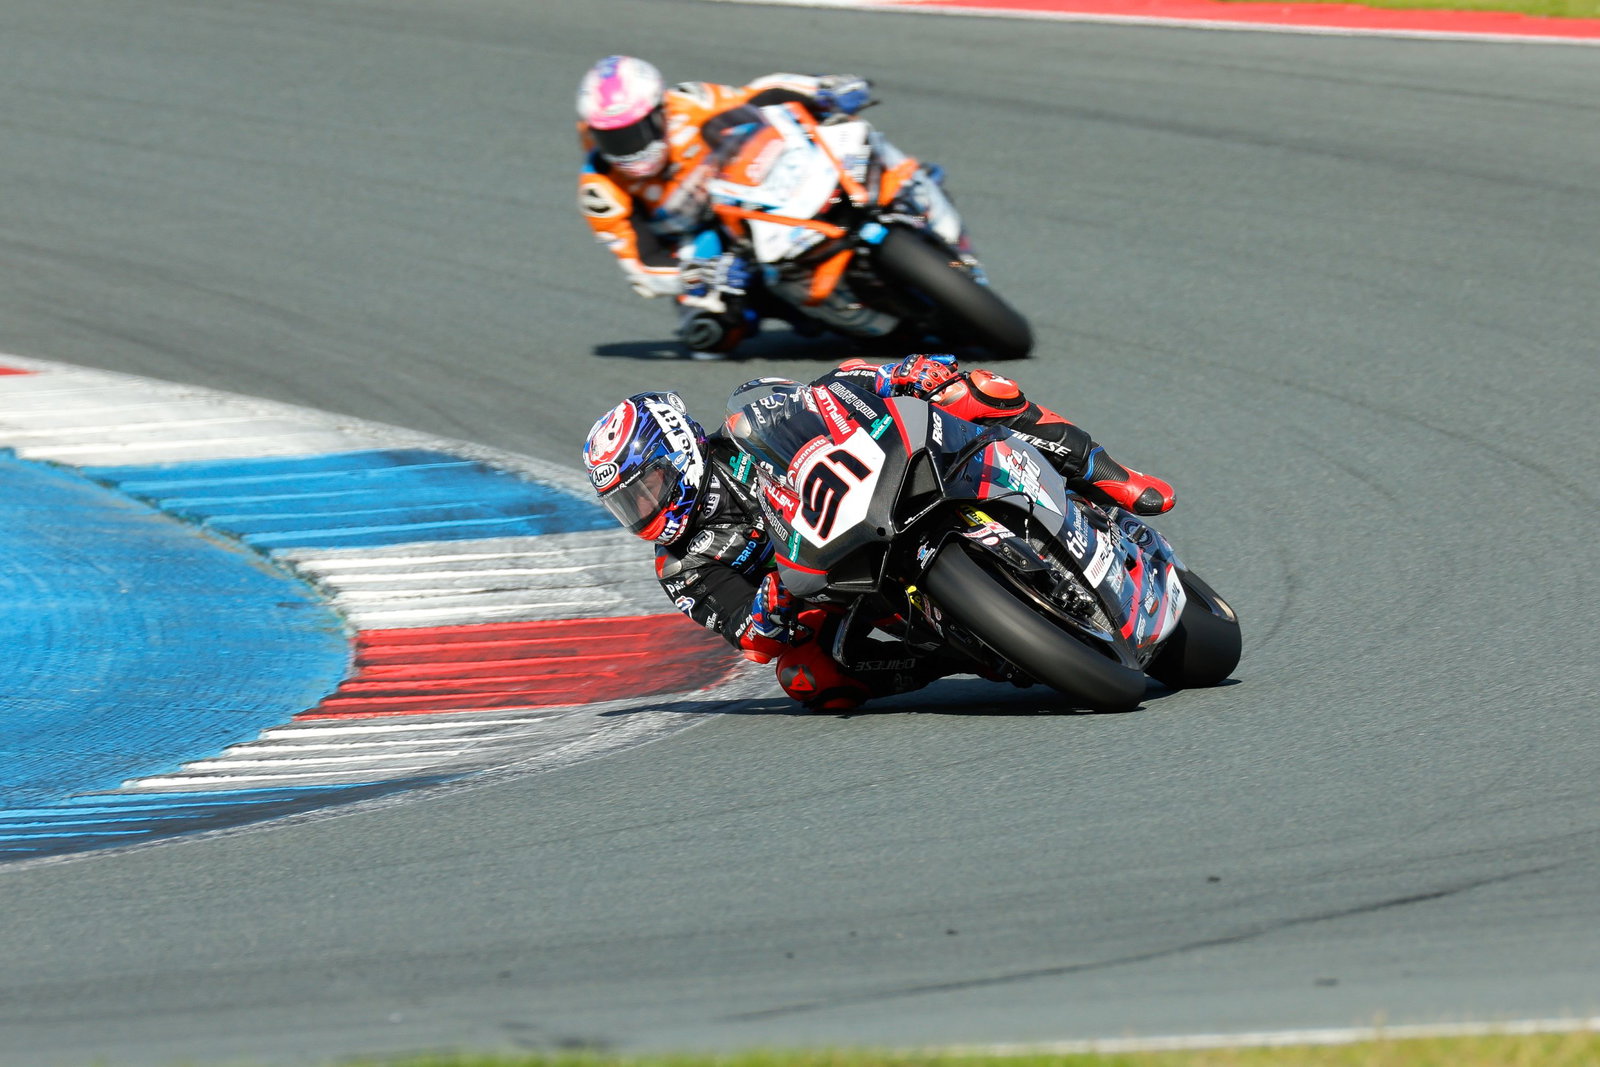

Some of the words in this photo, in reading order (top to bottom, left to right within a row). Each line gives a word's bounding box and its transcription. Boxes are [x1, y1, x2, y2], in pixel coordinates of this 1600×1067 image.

[828, 382, 858, 404] RAPIDO
[853, 399, 878, 420] moto
[932, 411, 943, 447] R&G
[793, 438, 827, 470] Bennetts
[593, 464, 614, 485] Arai
[801, 449, 873, 541] 91
